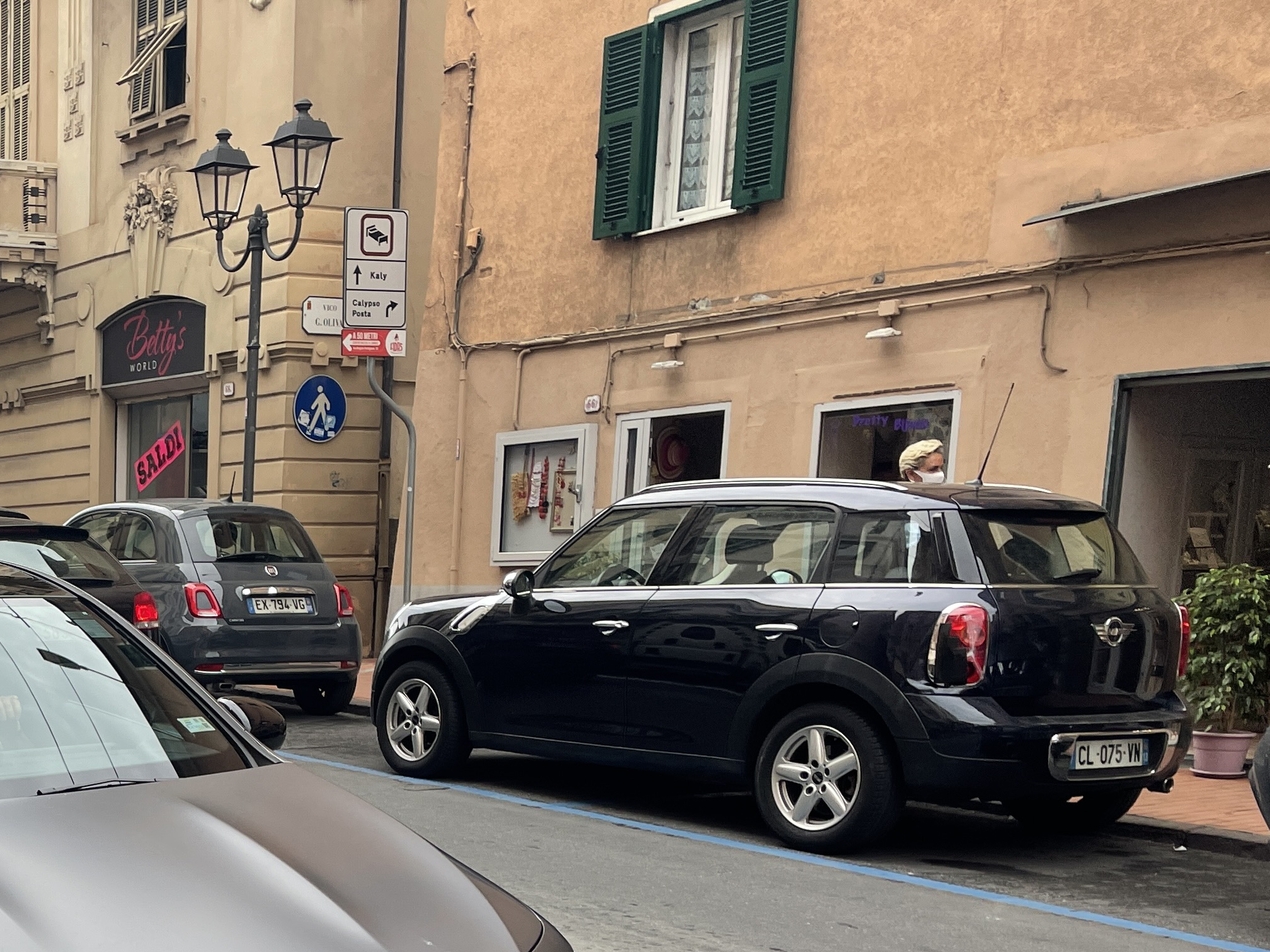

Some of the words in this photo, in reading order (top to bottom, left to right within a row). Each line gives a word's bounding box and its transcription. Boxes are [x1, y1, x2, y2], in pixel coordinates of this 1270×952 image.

[370, 272, 387, 281] Kaly
[352, 299, 380, 308] Calypso
[124, 309, 186, 376] Betty's
[130, 360, 158, 372] WORLD
[137, 425, 182, 484] SALDI
